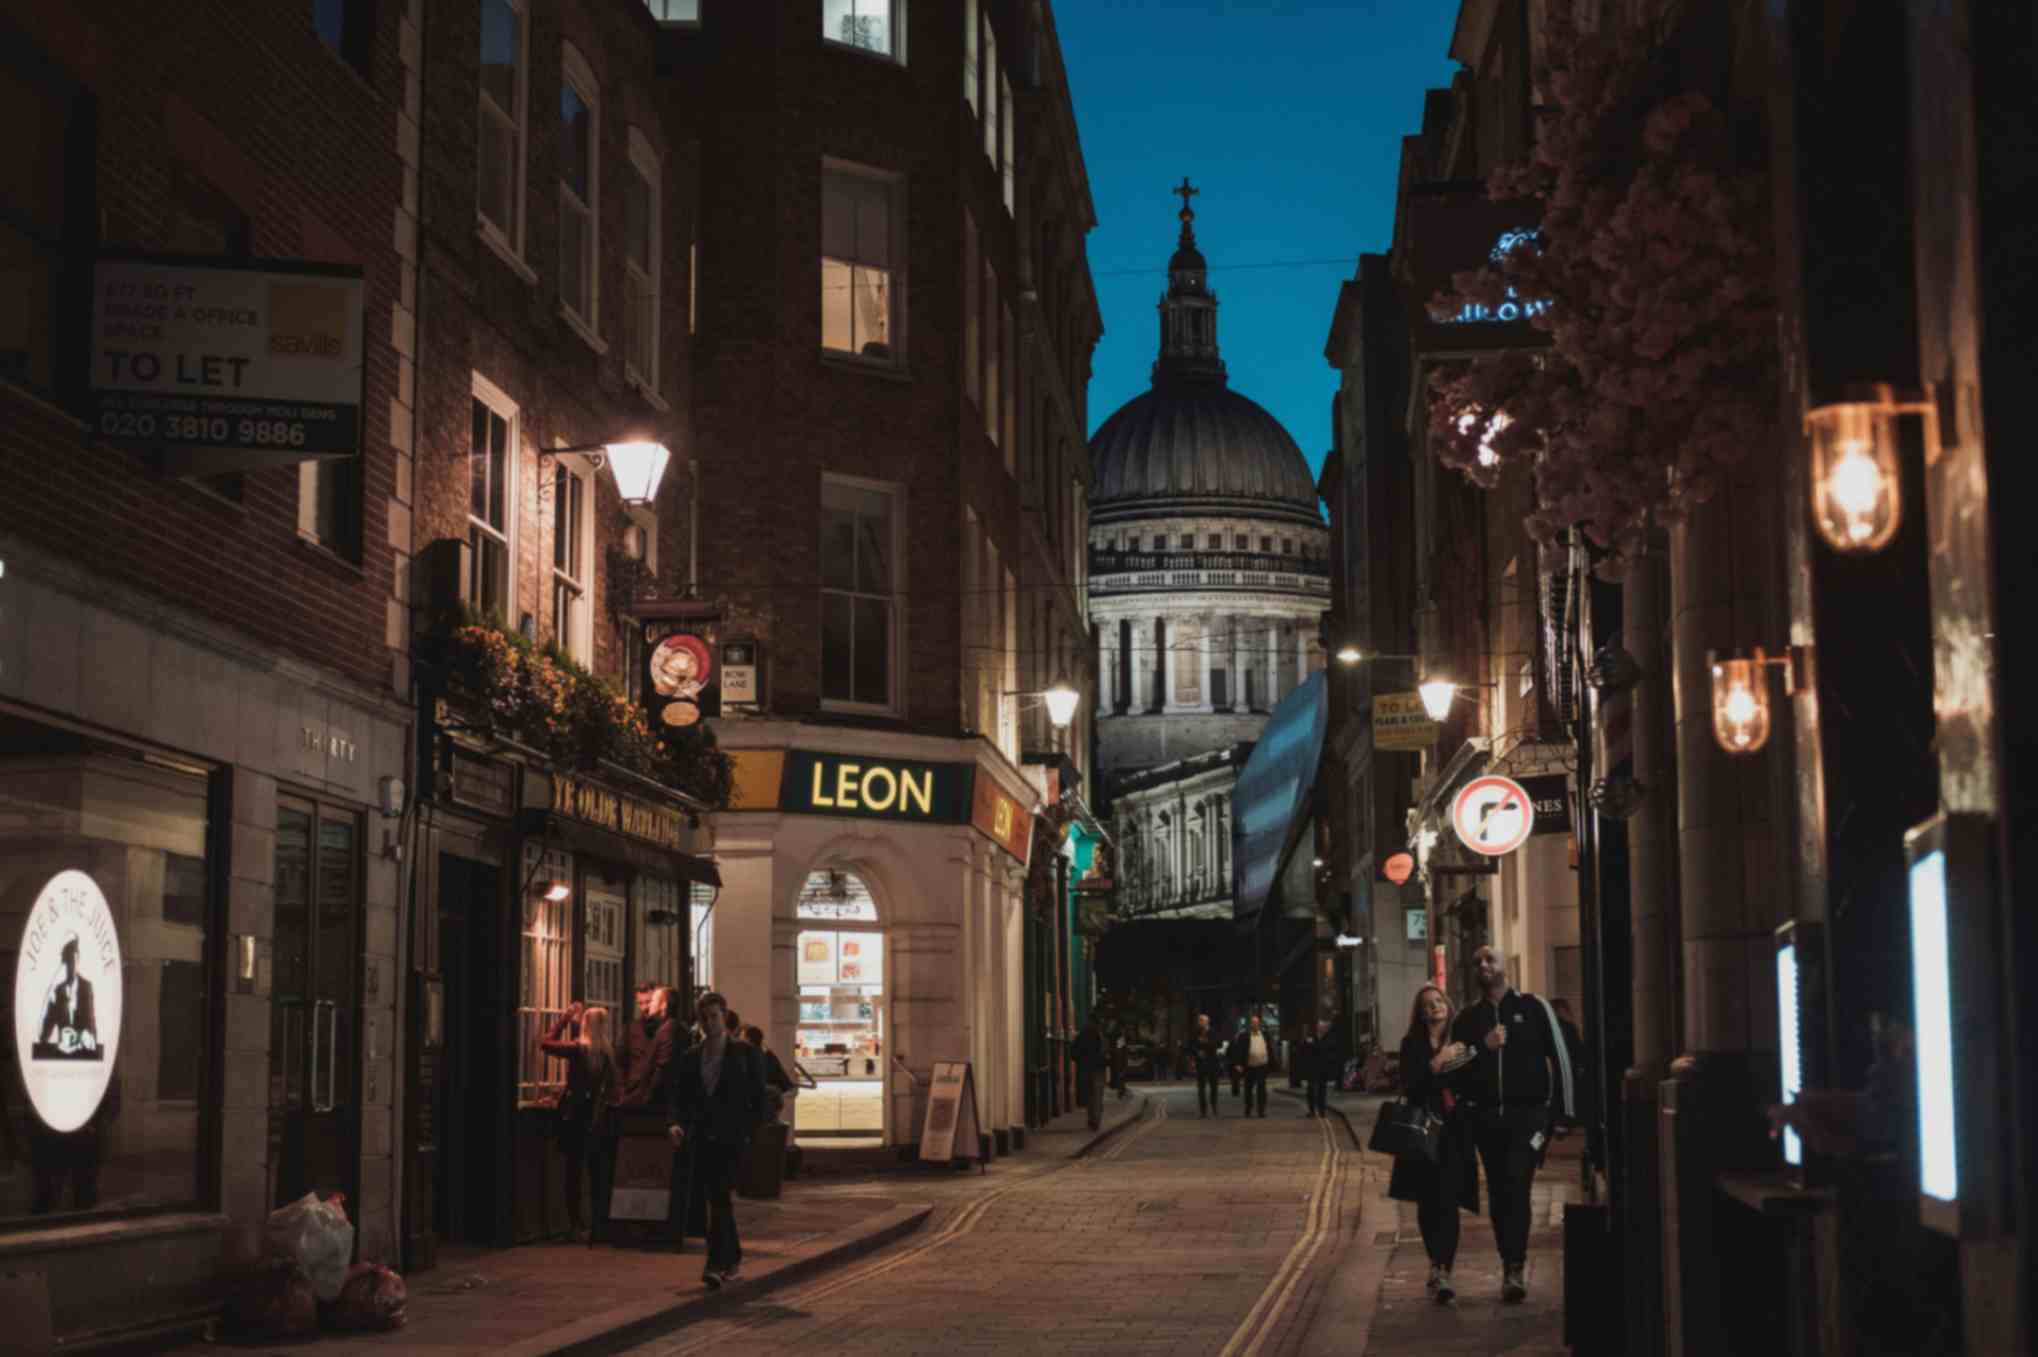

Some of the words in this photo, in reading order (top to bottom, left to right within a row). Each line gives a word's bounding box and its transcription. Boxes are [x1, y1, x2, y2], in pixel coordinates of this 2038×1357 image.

[192, 308, 258, 327] OFFICE
[104, 351, 160, 383] TO
[176, 354, 253, 387] LET
[101, 410, 156, 437] 020
[164, 414, 229, 441] 3810
[239, 418, 305, 447] 9886
[811, 761, 933, 815] LEON
[61, 886, 89, 919] THE
